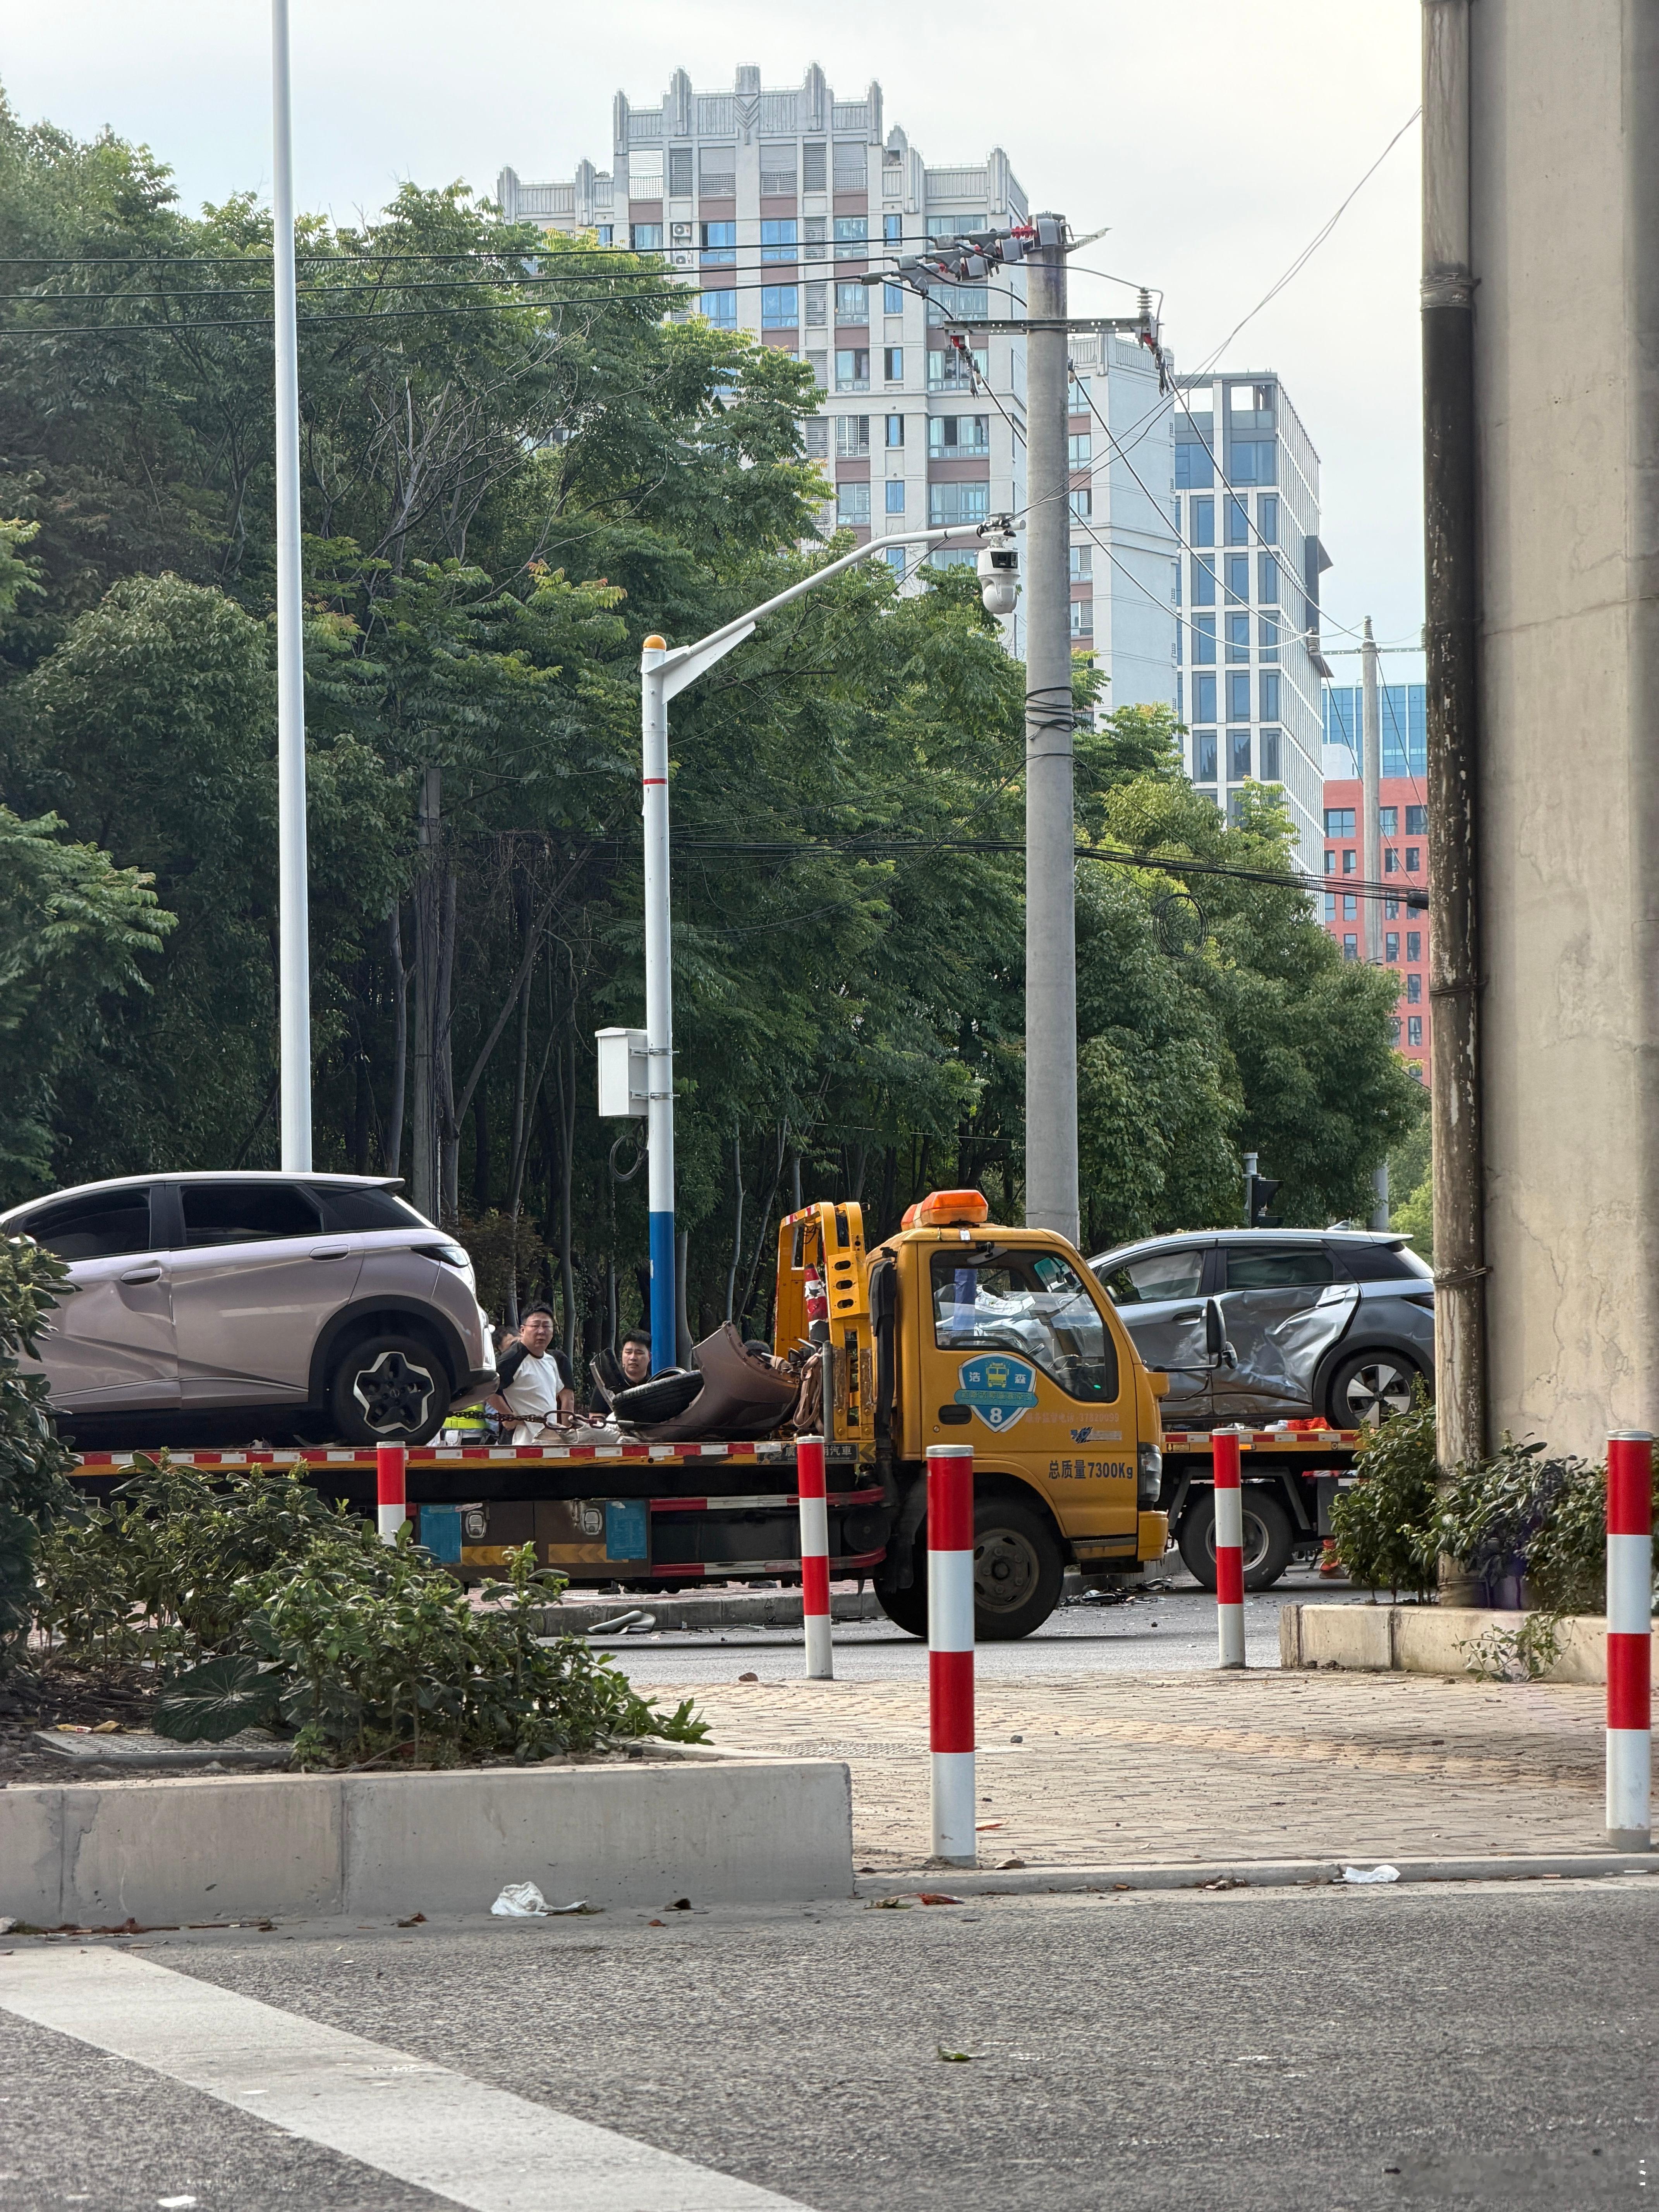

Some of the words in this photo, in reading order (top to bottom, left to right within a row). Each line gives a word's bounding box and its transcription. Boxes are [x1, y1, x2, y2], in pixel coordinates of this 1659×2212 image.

[969, 1371, 981, 1382] 浩
[1014, 1374, 1026, 1384] 森
[989, 1407, 1003, 1424] 8
[1048, 1460, 1133, 1479] 总质量7300Kg
